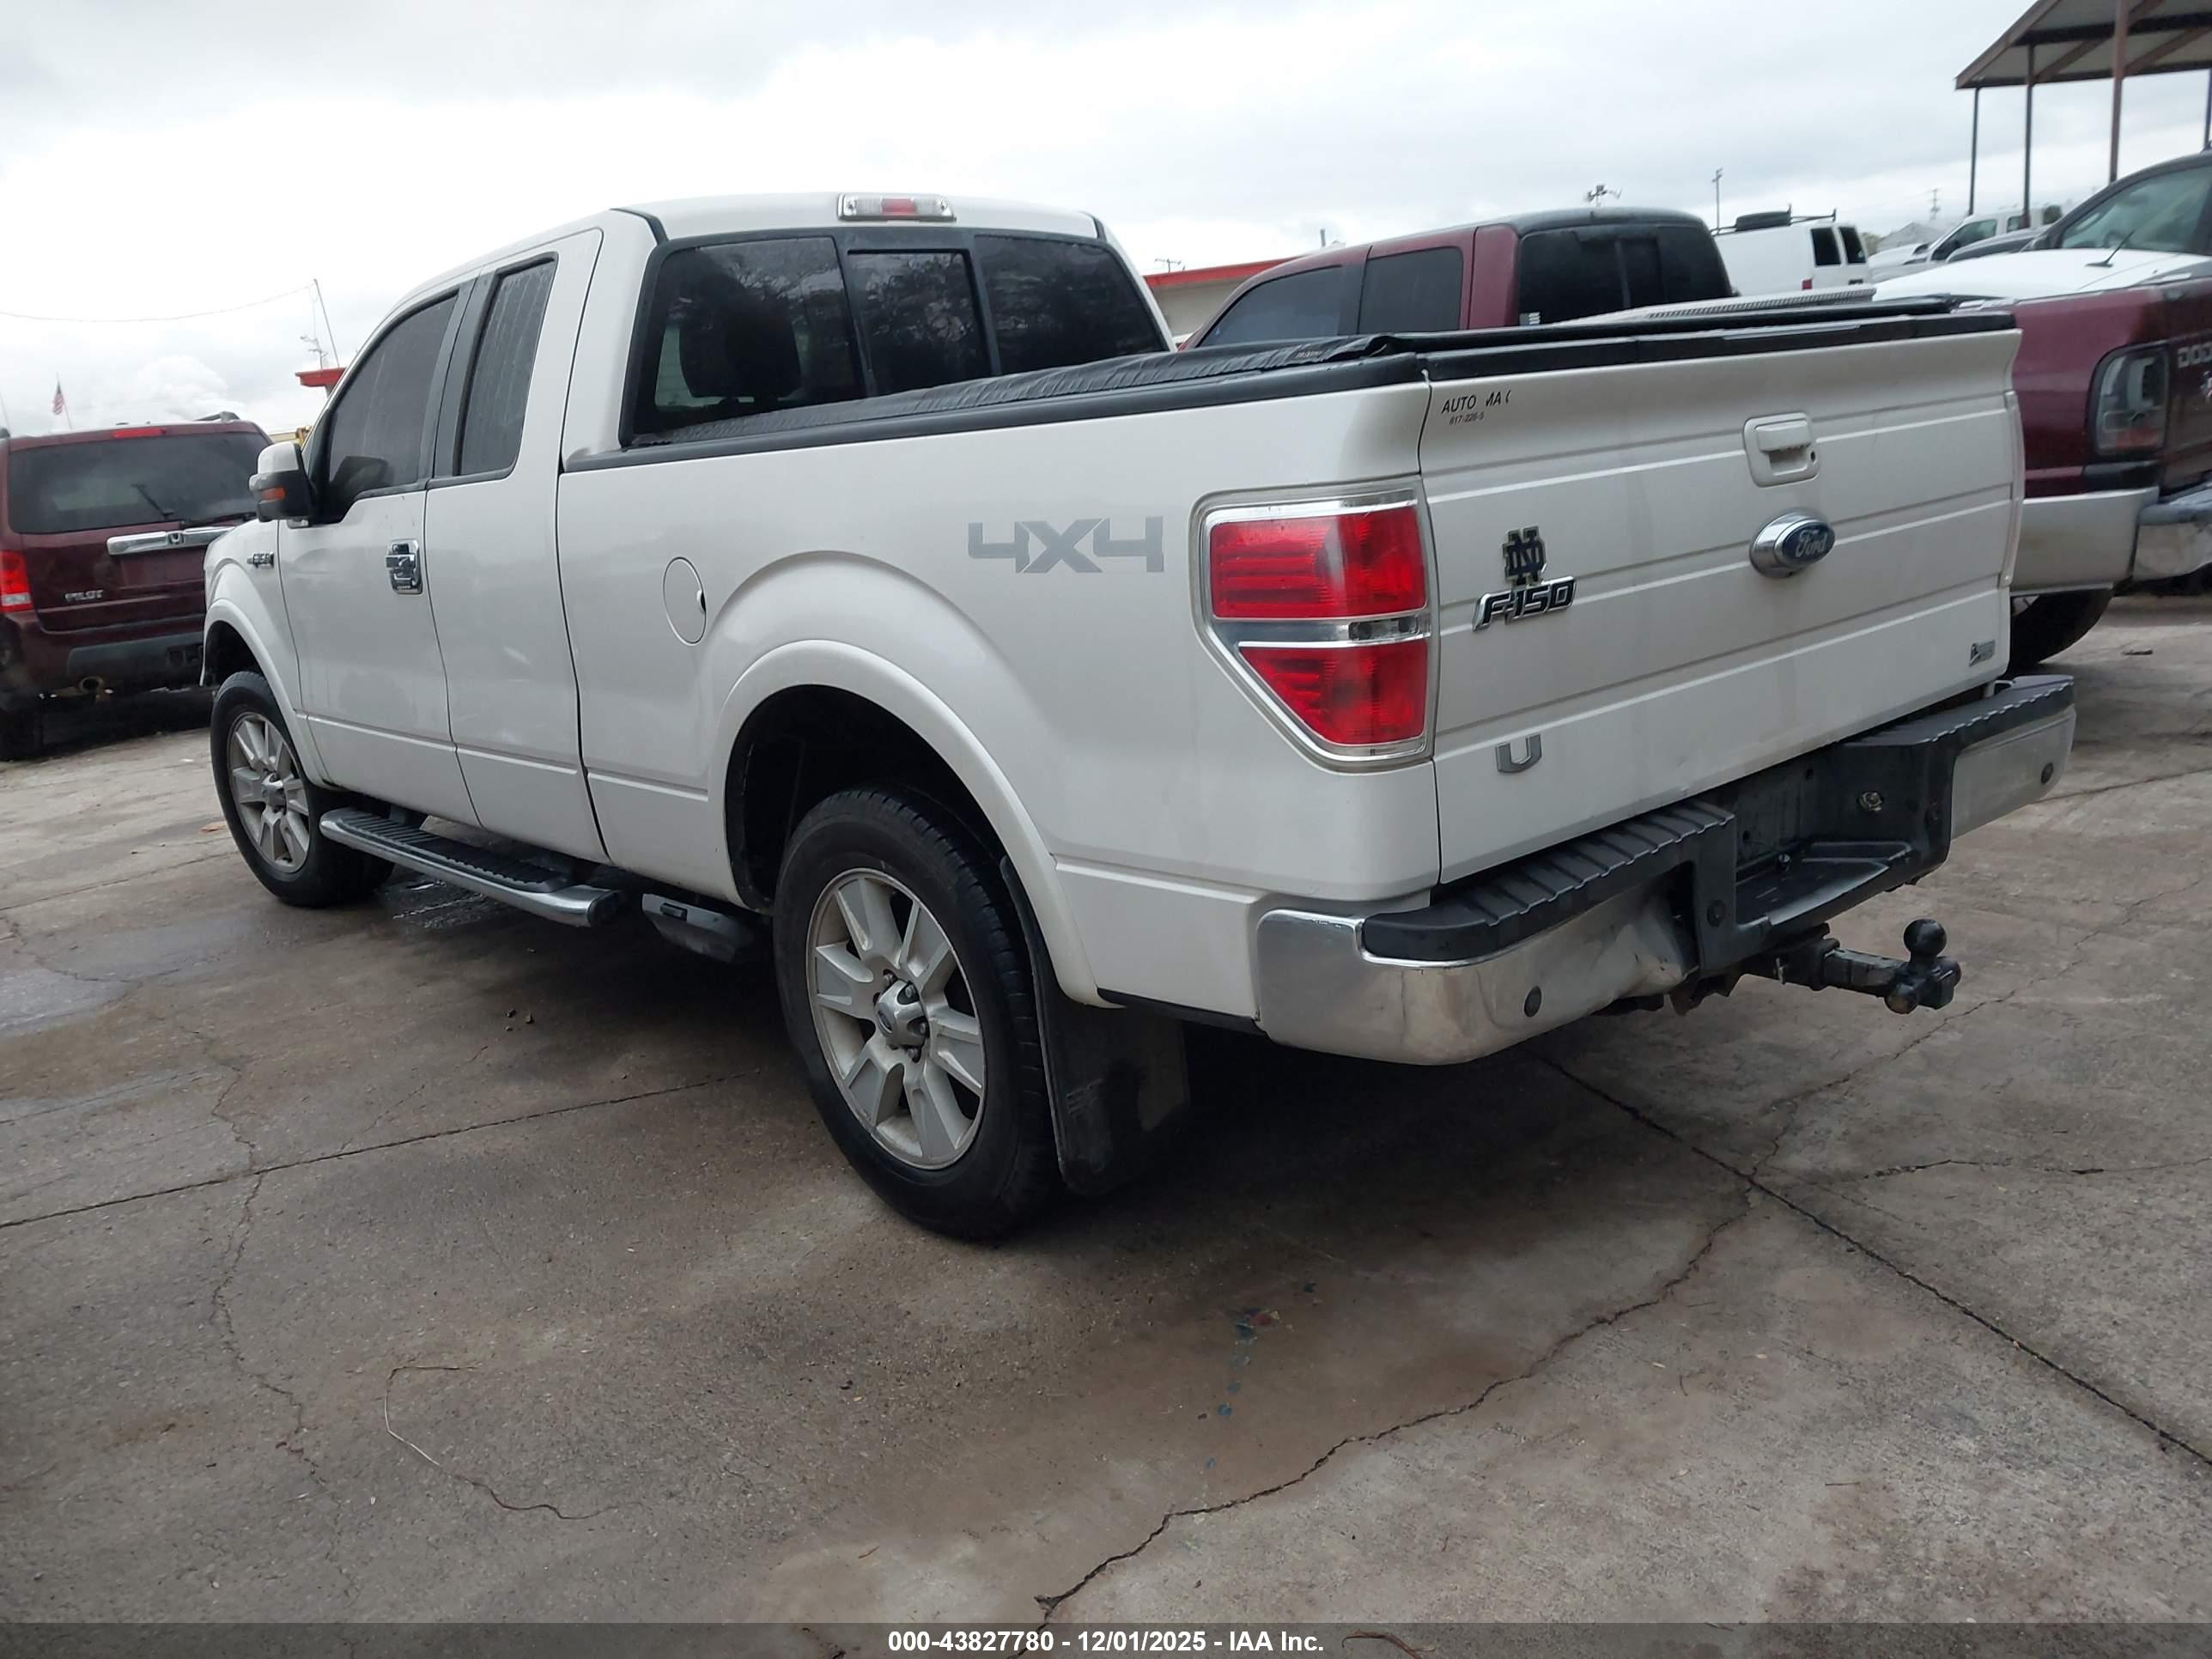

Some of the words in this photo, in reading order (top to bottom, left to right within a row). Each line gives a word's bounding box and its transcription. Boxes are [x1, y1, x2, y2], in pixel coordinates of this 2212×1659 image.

[1441, 394, 1477, 414] AUTO
[968, 515, 1164, 574] 4X4
[1795, 528, 1829, 558] Ford
[64, 589, 104, 602] PILOT
